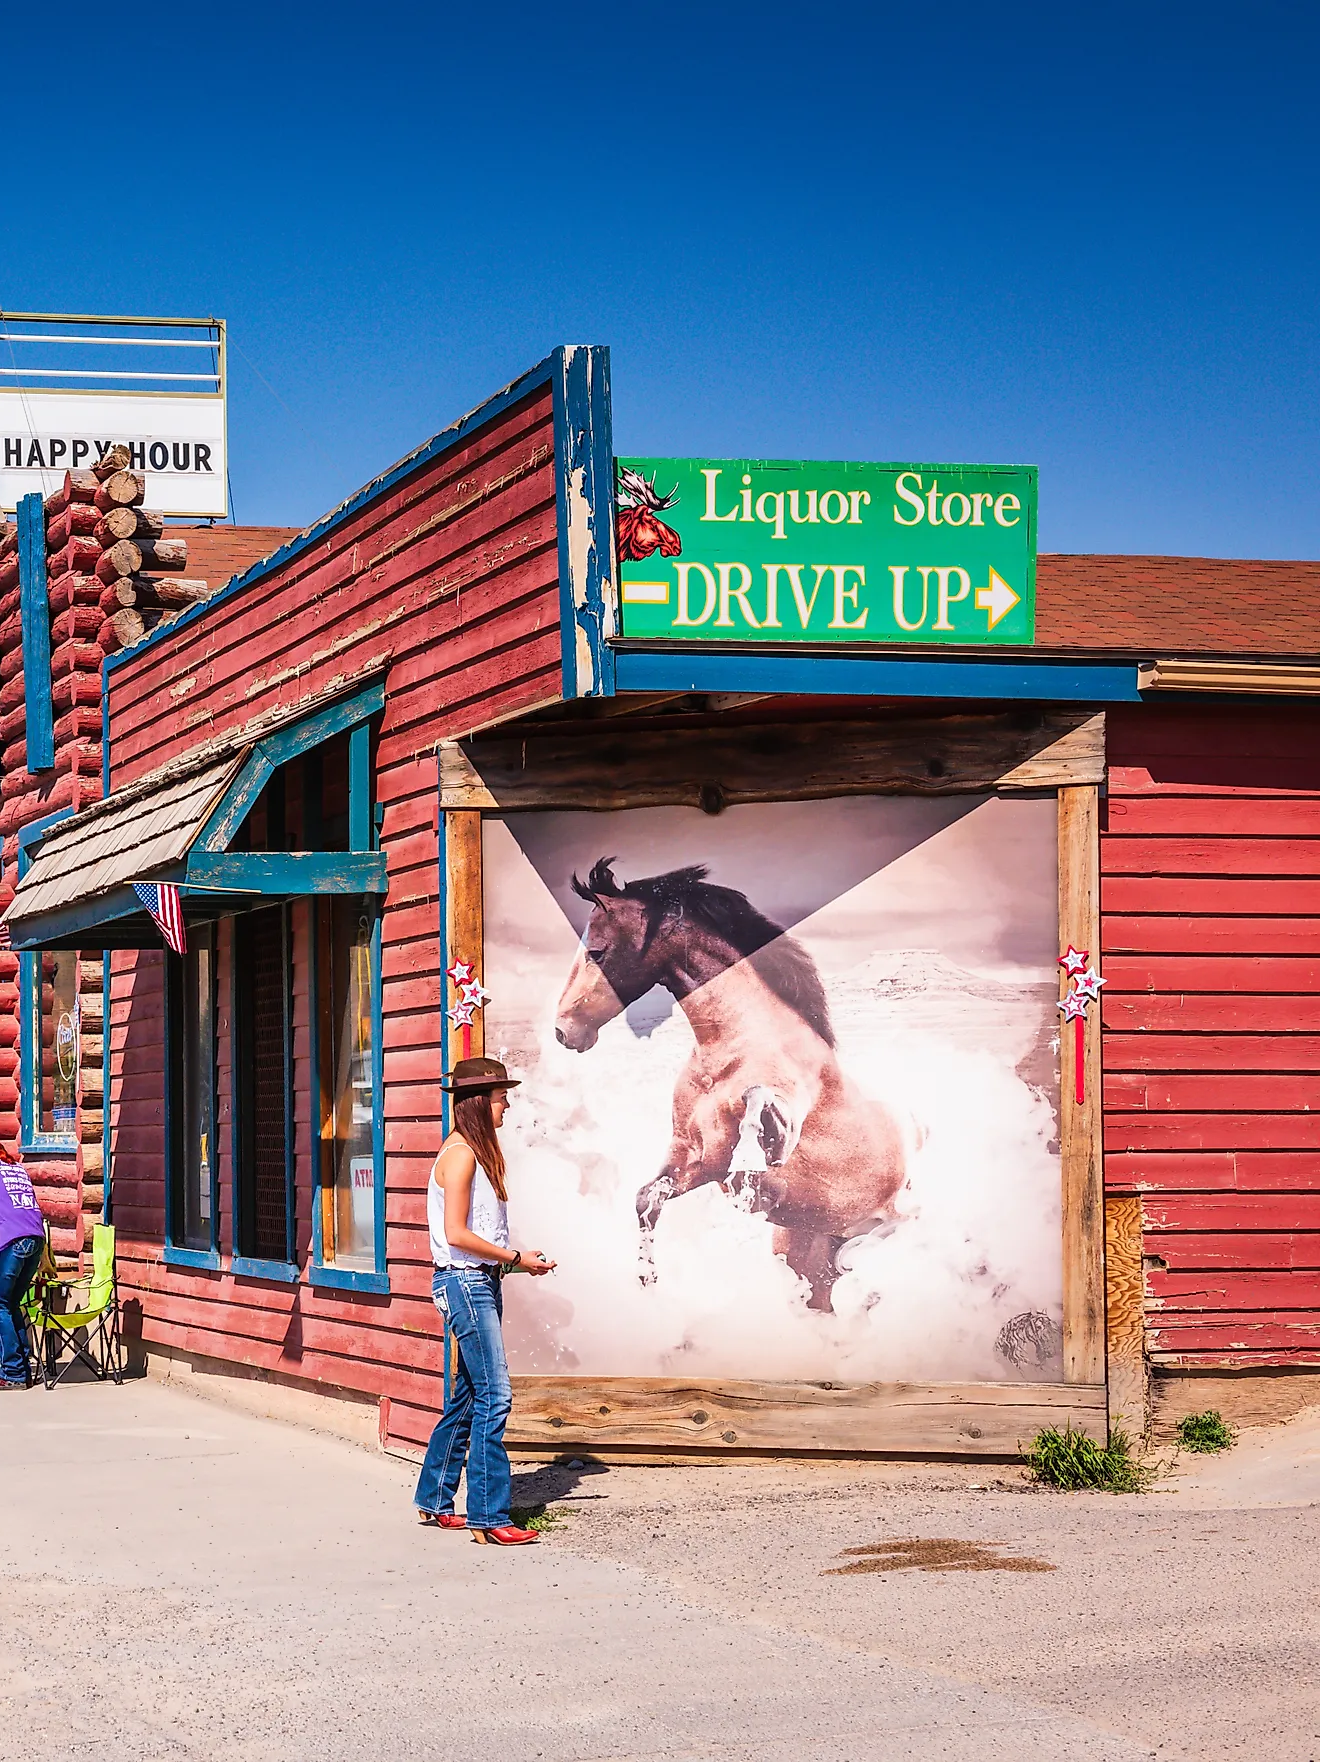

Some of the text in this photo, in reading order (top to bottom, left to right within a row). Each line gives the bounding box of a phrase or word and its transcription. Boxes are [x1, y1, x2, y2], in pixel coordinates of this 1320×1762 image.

[4, 438, 213, 471] HAPPY HOUR
[700, 469, 1021, 539] Liquor Store
[672, 562, 971, 631] DRIVE UP
